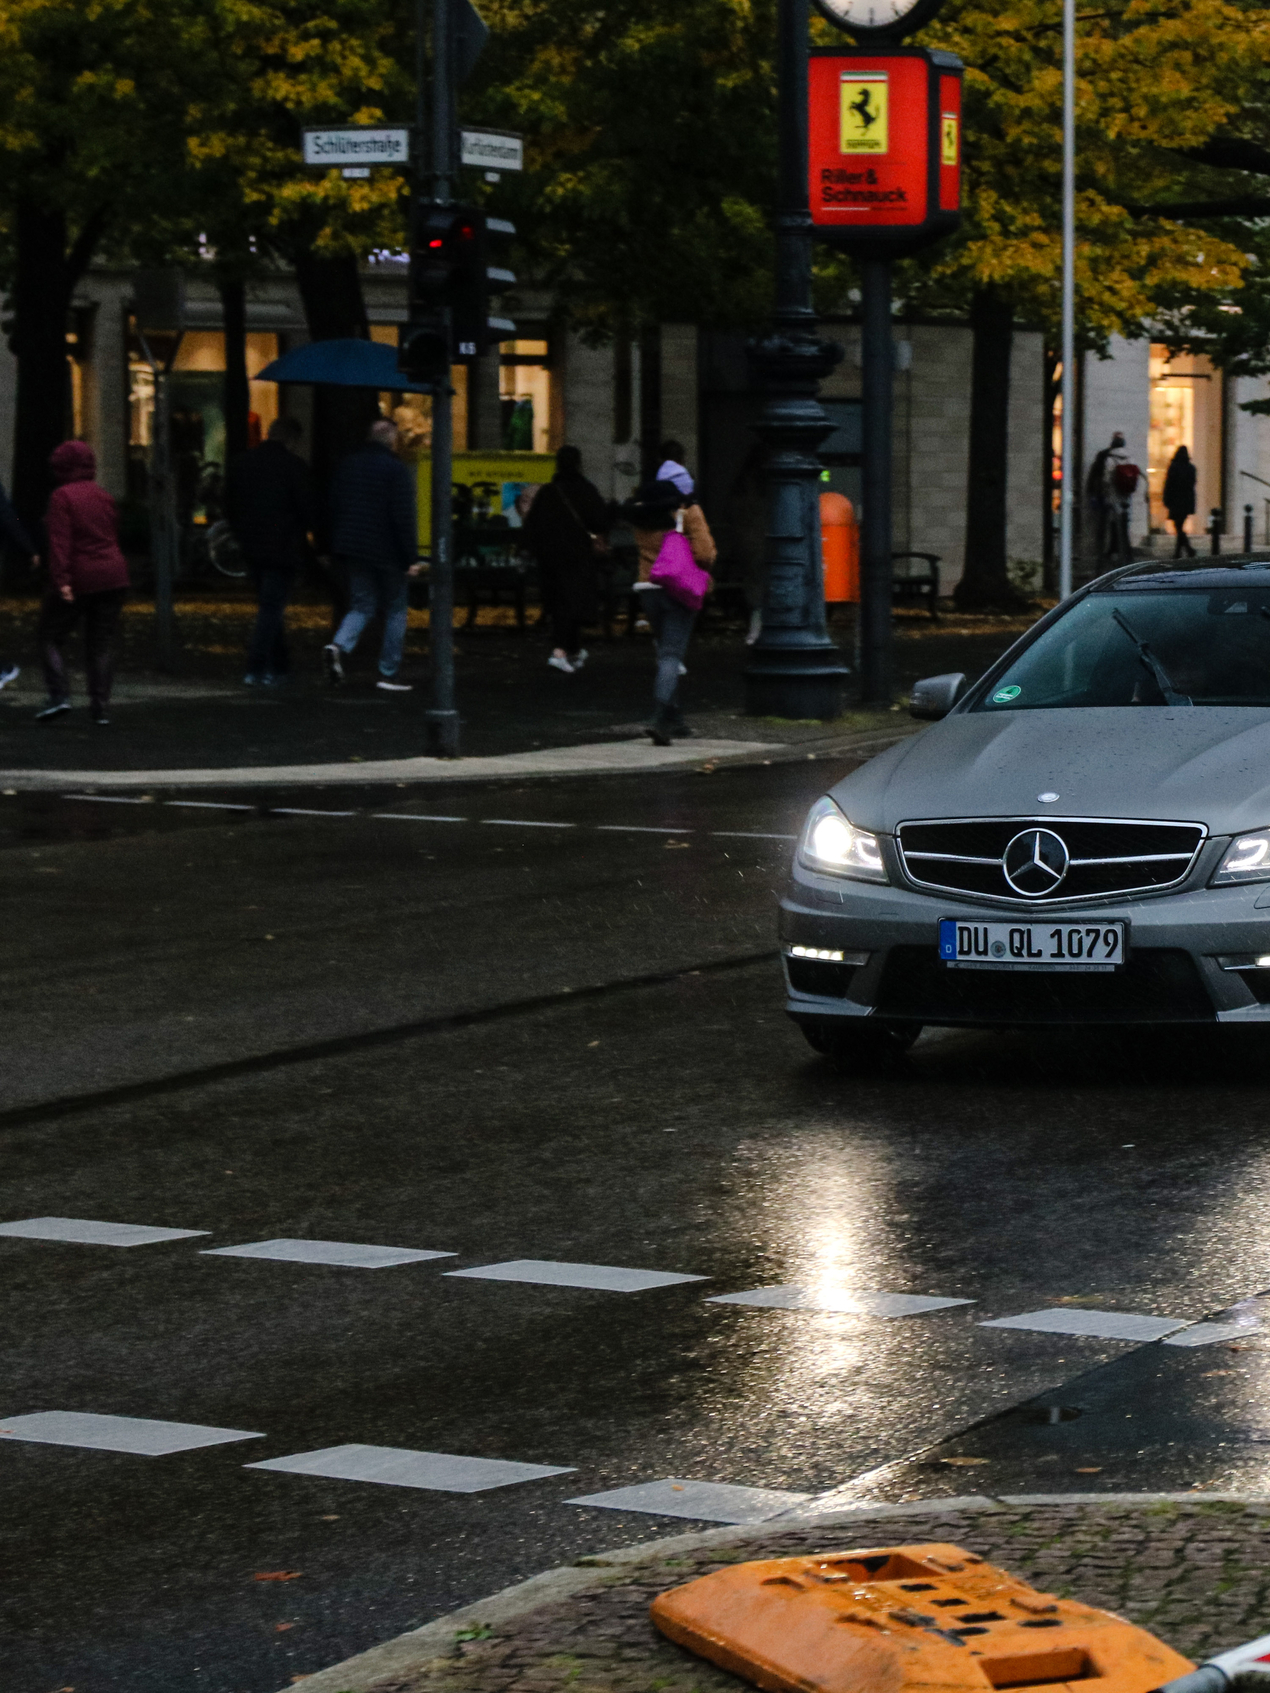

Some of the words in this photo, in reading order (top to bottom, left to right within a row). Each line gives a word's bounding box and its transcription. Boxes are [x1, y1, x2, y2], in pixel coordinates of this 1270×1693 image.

[312, 134, 402, 157] Schlüterstraße
[821, 168, 863, 185] Riller
[866, 168, 878, 185] &
[821, 186, 908, 203] Schnauck
[957, 926, 989, 956] DU
[1009, 928, 1043, 958] QL
[1050, 928, 1119, 958] 1079
